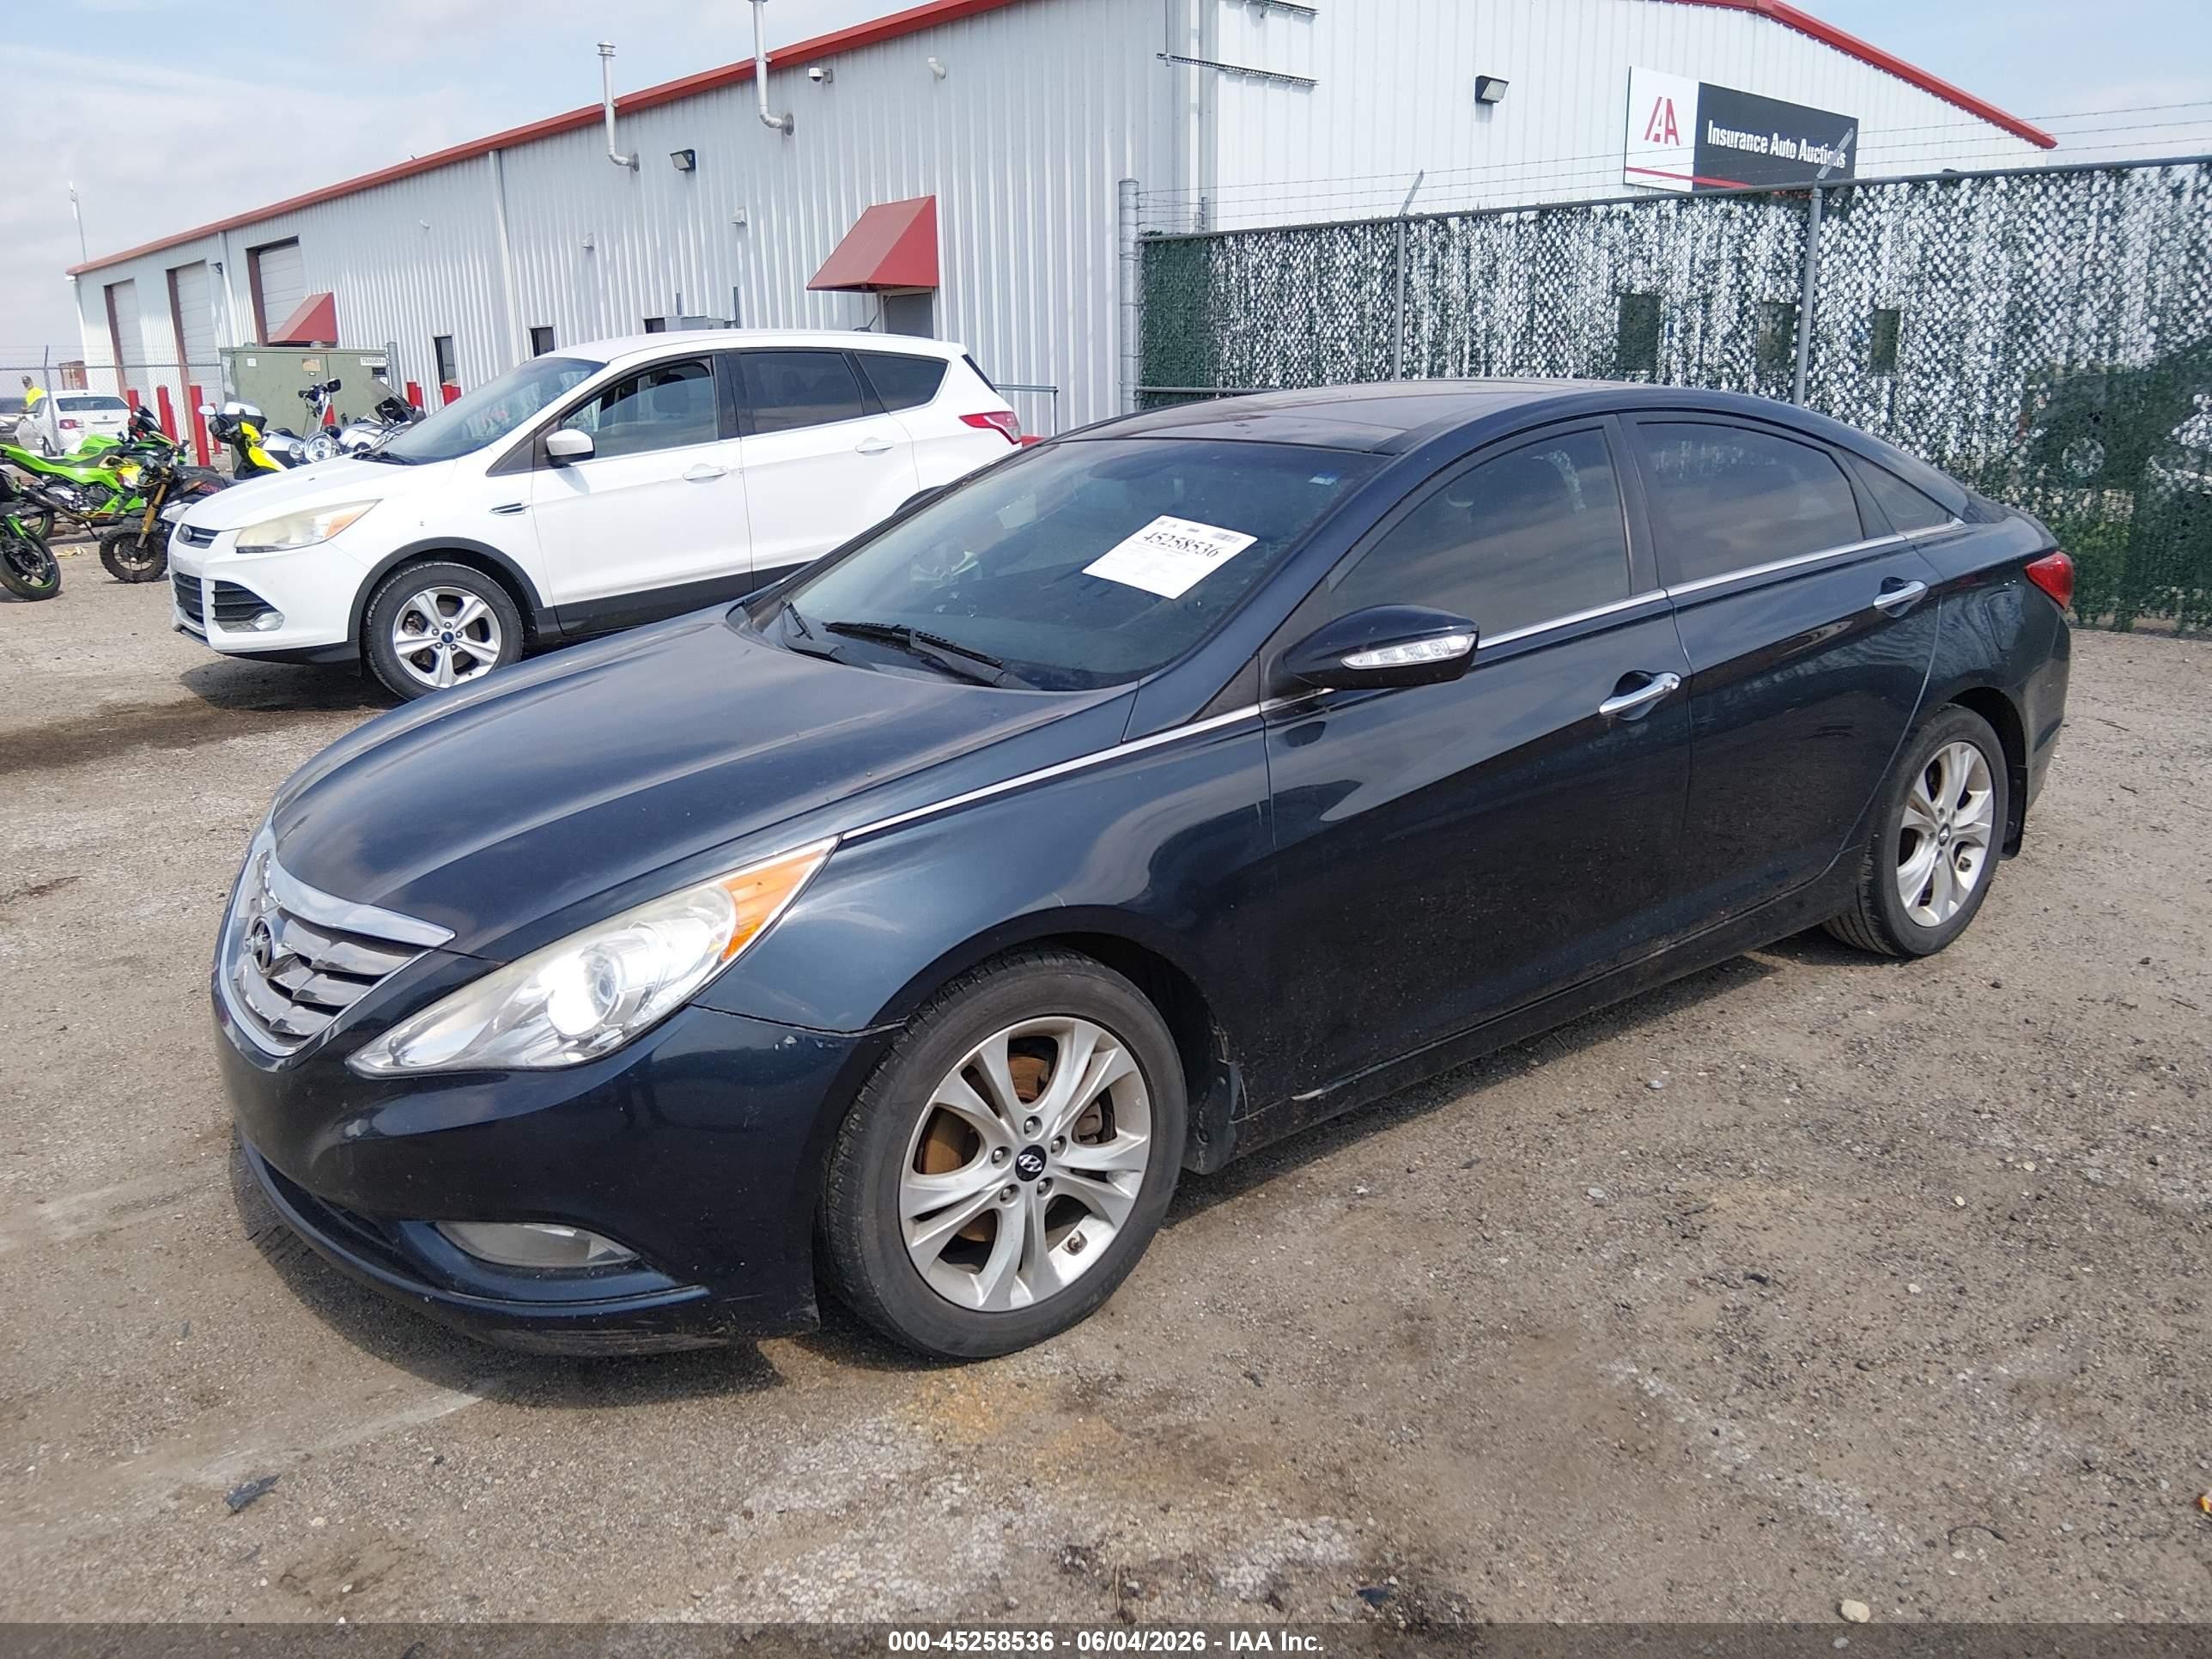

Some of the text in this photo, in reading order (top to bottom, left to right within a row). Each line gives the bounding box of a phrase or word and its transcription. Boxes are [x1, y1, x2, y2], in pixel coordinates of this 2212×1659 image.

[1707, 119, 1768, 154] Insurance
[1769, 132, 1797, 160] Auto
[1143, 532, 1224, 557] 45258536
